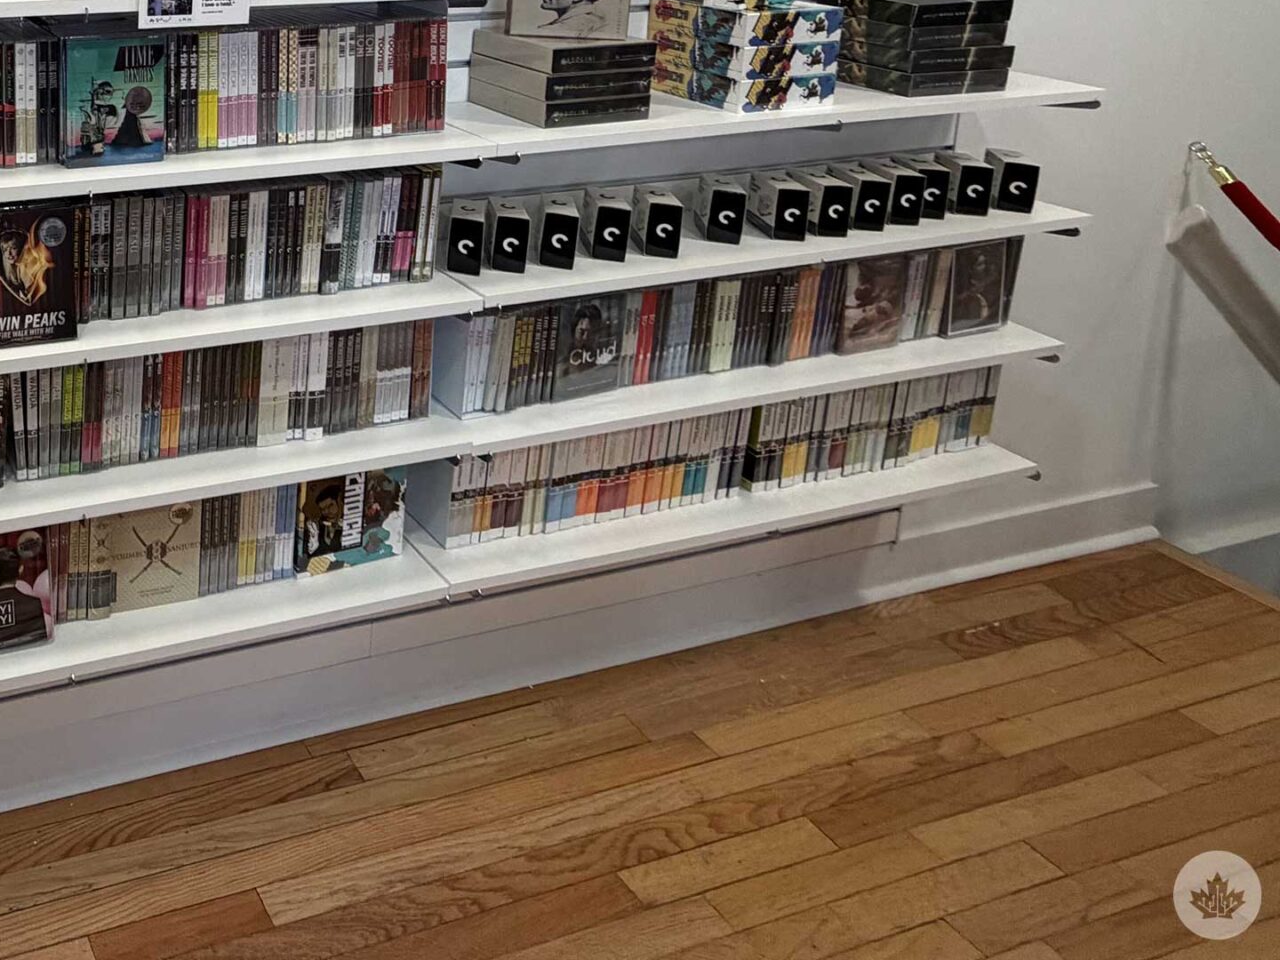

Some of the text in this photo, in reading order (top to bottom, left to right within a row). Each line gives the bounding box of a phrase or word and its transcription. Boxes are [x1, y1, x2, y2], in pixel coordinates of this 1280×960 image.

[199, 54, 208, 91] FURNITURE
[209, 53, 218, 90] FURNITURE
[24, 311, 66, 329] PEAKS
[13, 378, 22, 410] WANDA
[28, 376, 37, 408] WANDA
[0, 604, 12, 614] YI
[0, 614, 12, 625] YI
